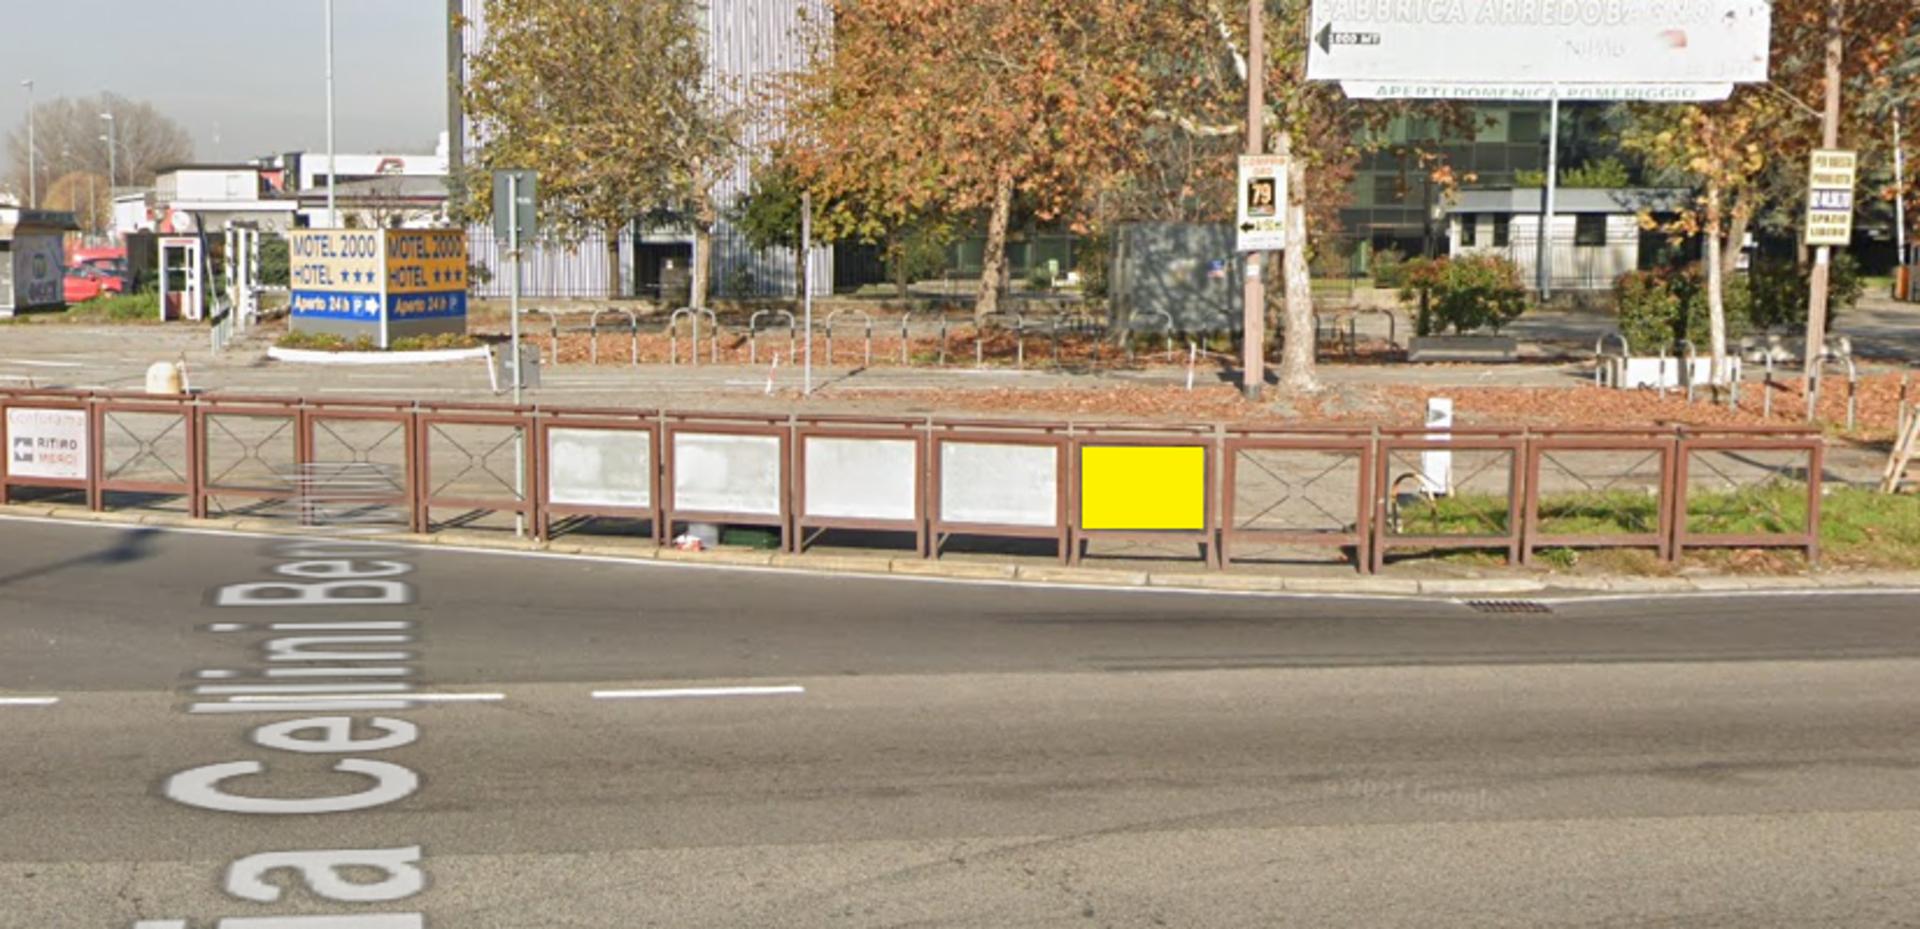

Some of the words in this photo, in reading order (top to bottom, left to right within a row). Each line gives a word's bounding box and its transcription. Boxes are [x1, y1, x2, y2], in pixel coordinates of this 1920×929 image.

[1317, 0, 1466, 24] FABBRICA
[1376, 85, 1446, 97] APERTI
[1453, 85, 1559, 98] DOMENICA
[1567, 86, 1697, 98] POMERIGGIO
[1251, 183, 1272, 204] 79
[1812, 213, 1848, 224] SPAZIO
[293, 234, 338, 258] MOTEL
[341, 234, 376, 259] 2000
[388, 235, 430, 259] MOTEL
[432, 234, 462, 259] 2000
[292, 264, 334, 285] HOTEL
[389, 264, 428, 287] HOTEL
[295, 294, 328, 314] Aperto
